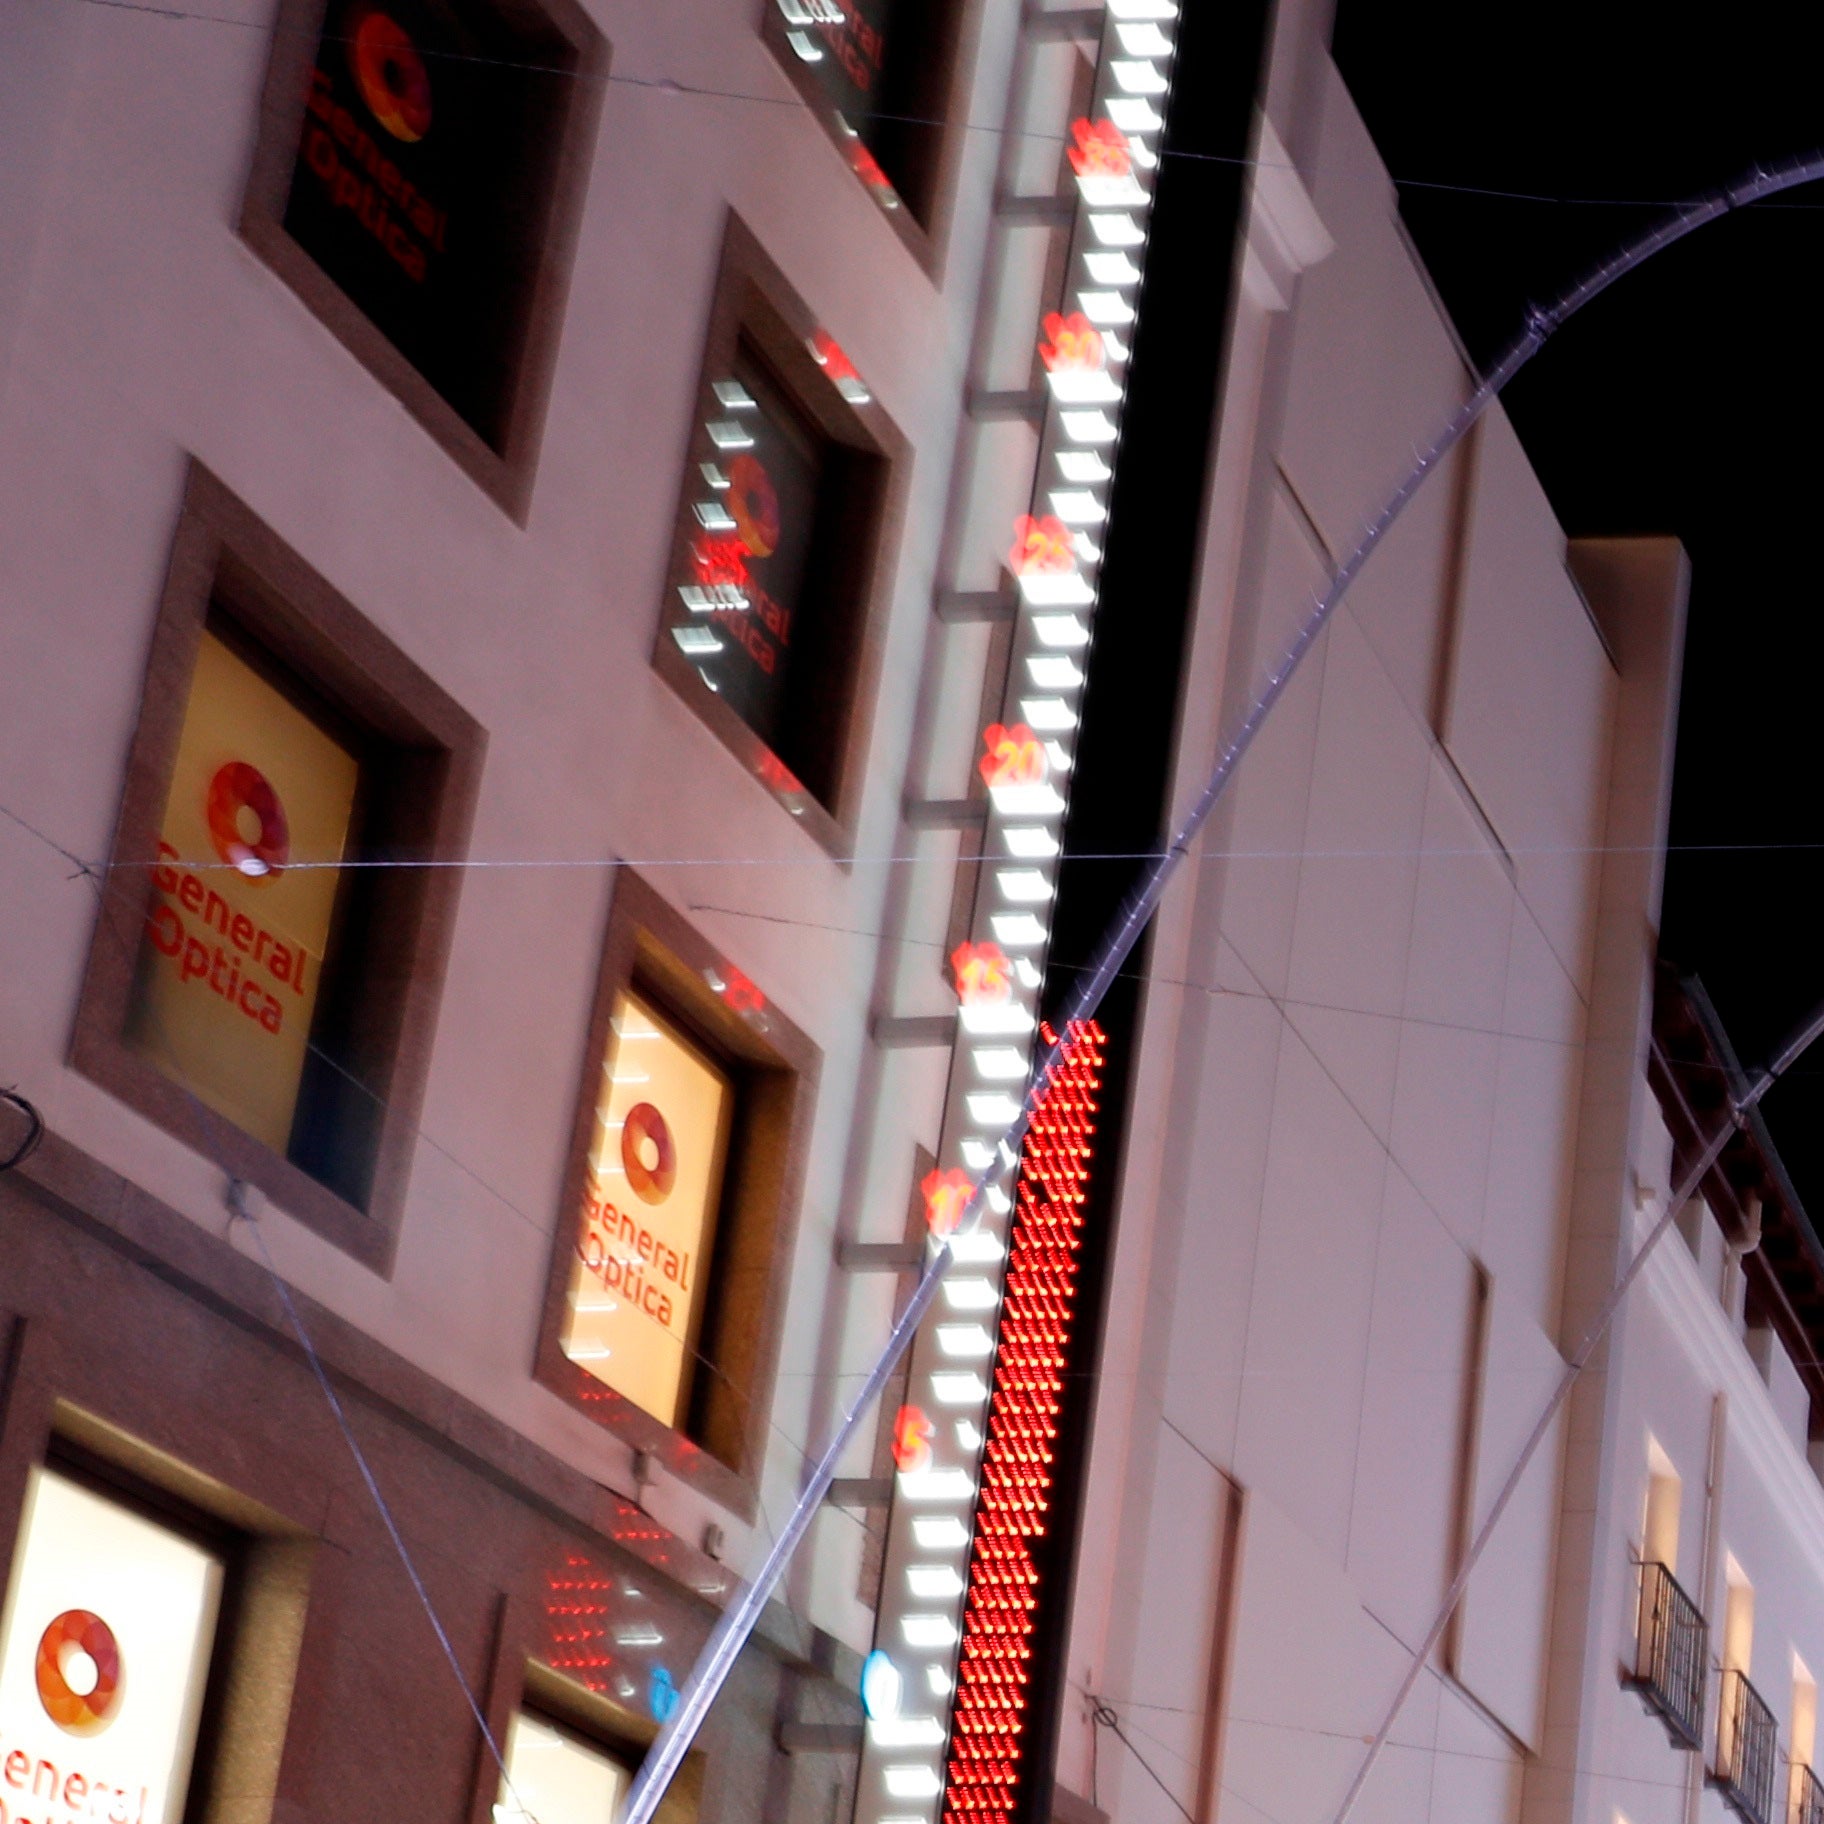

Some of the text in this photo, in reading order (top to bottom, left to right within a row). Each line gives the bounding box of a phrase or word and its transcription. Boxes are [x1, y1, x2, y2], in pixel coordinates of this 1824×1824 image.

[984, 730, 1047, 788] 20
[151, 905, 283, 1036] Optica
[577, 1232, 673, 1328] Optica
